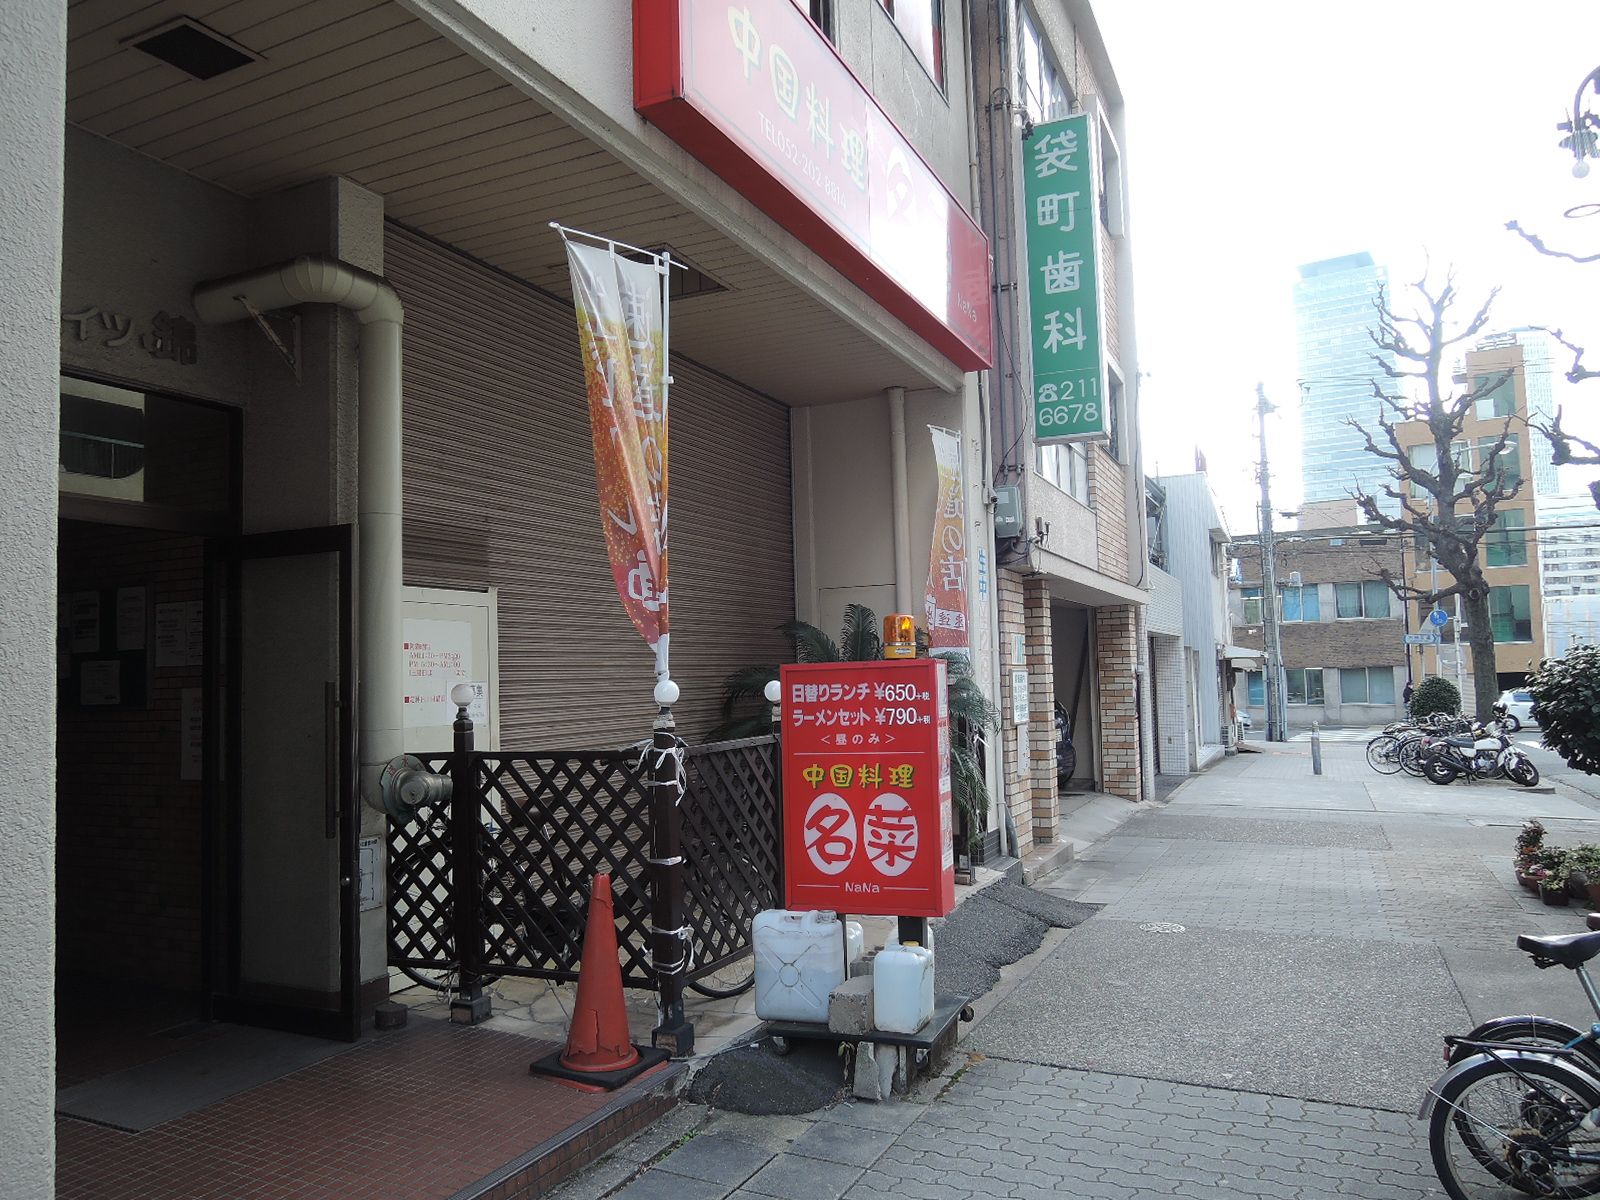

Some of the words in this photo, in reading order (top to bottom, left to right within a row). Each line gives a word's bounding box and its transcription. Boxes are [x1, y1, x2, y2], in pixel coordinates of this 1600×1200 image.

[727, 6, 867, 193] 中国料理
[1033, 128, 1087, 354] 袋町歯科
[1060, 377, 1097, 400] 211
[1039, 402, 1098, 427] 6678
[792, 682, 870, 702] 日替りランチ
[792, 707, 871, 727] ラーメンセット
[803, 763, 915, 789] 中国料理
[845, 882, 880, 893] NaNa
